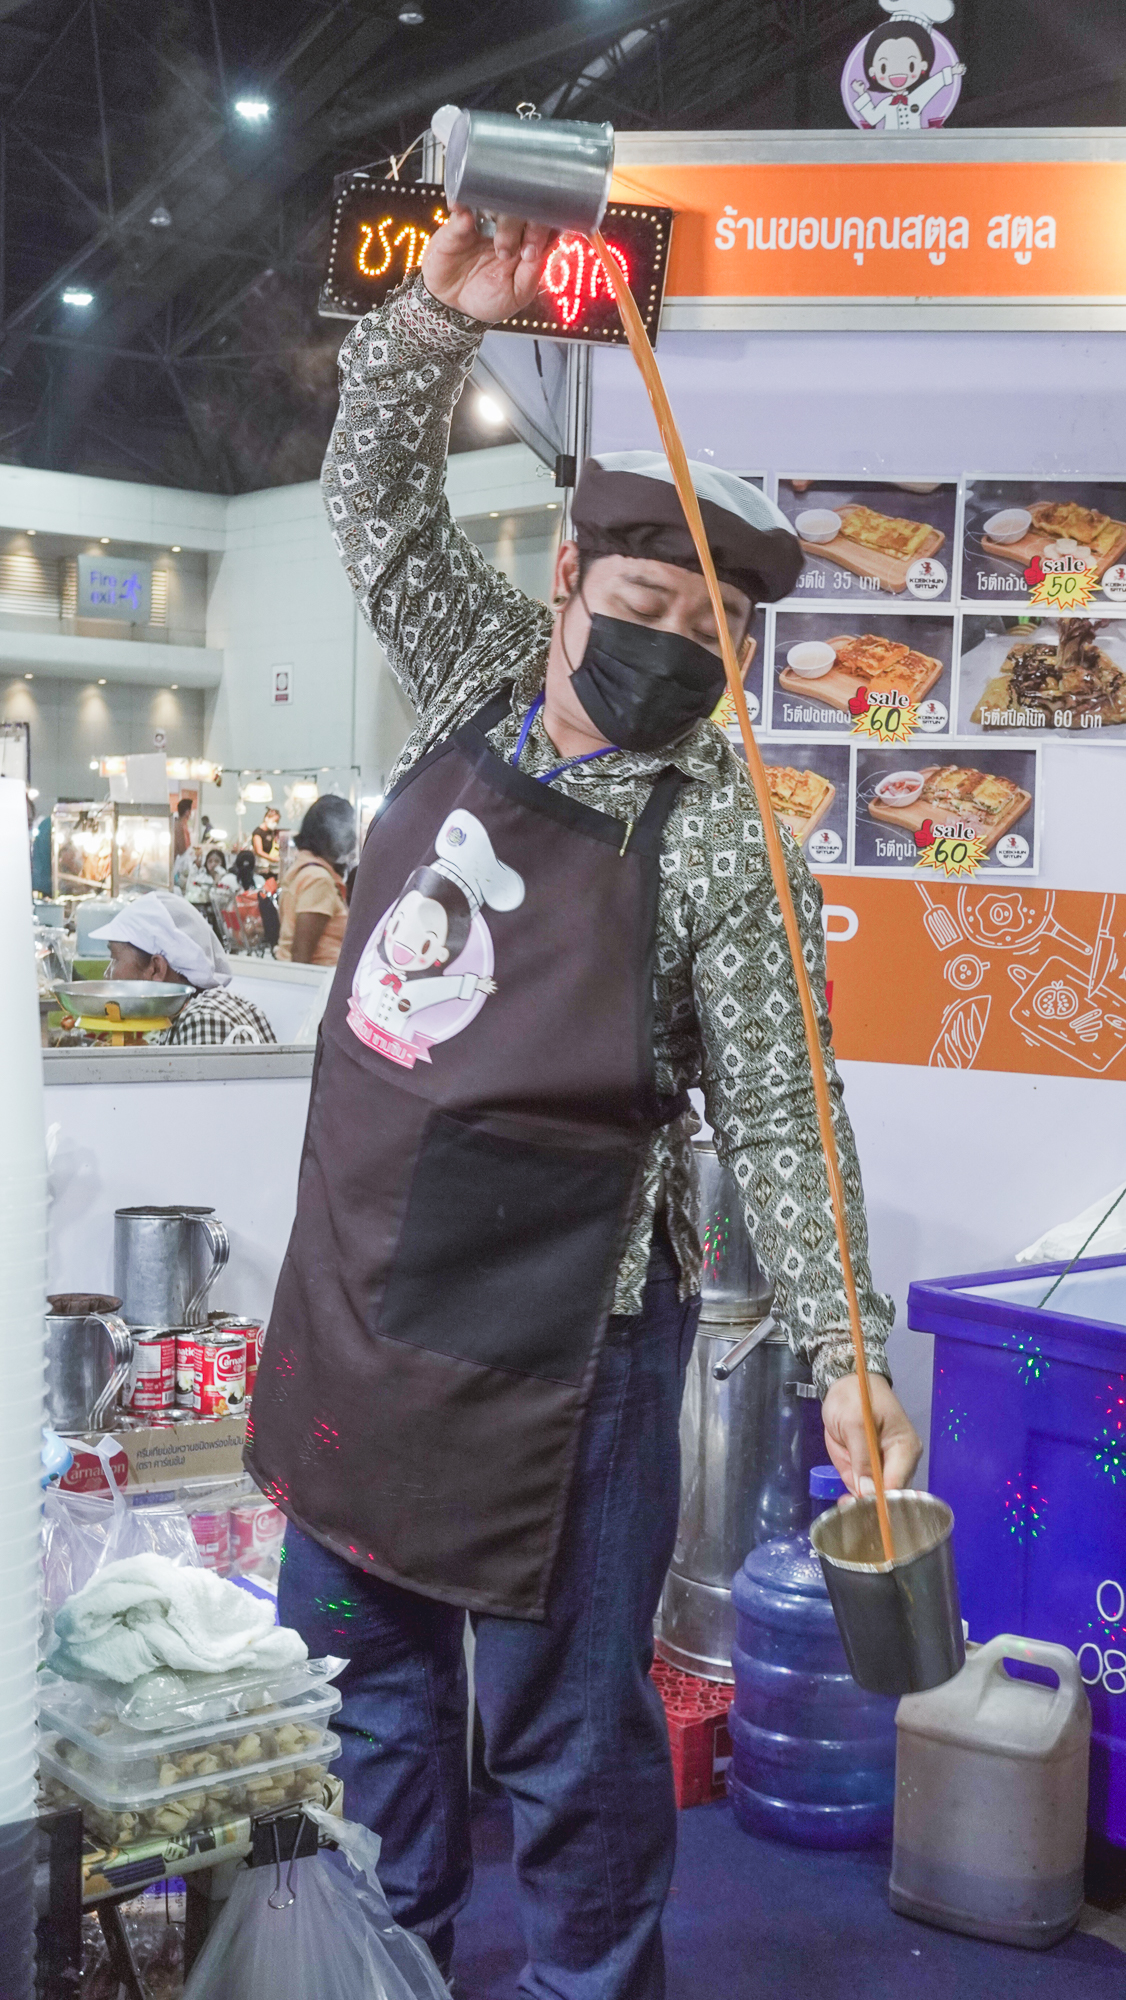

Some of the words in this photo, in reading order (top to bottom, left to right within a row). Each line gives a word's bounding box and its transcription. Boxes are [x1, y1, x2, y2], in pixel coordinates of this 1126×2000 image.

[714, 205, 969, 266] ร้านขอบคุณสตูล
[986, 213, 1057, 266] สตูล
[1043, 556, 1084, 572] sale
[833, 571, 852, 590] 35
[1047, 576, 1077, 597] 50
[868, 691, 909, 707] sale
[870, 706, 901, 732] 60
[1053, 709, 1073, 728] 60
[933, 824, 975, 840] sale
[934, 839, 967, 864] 60
